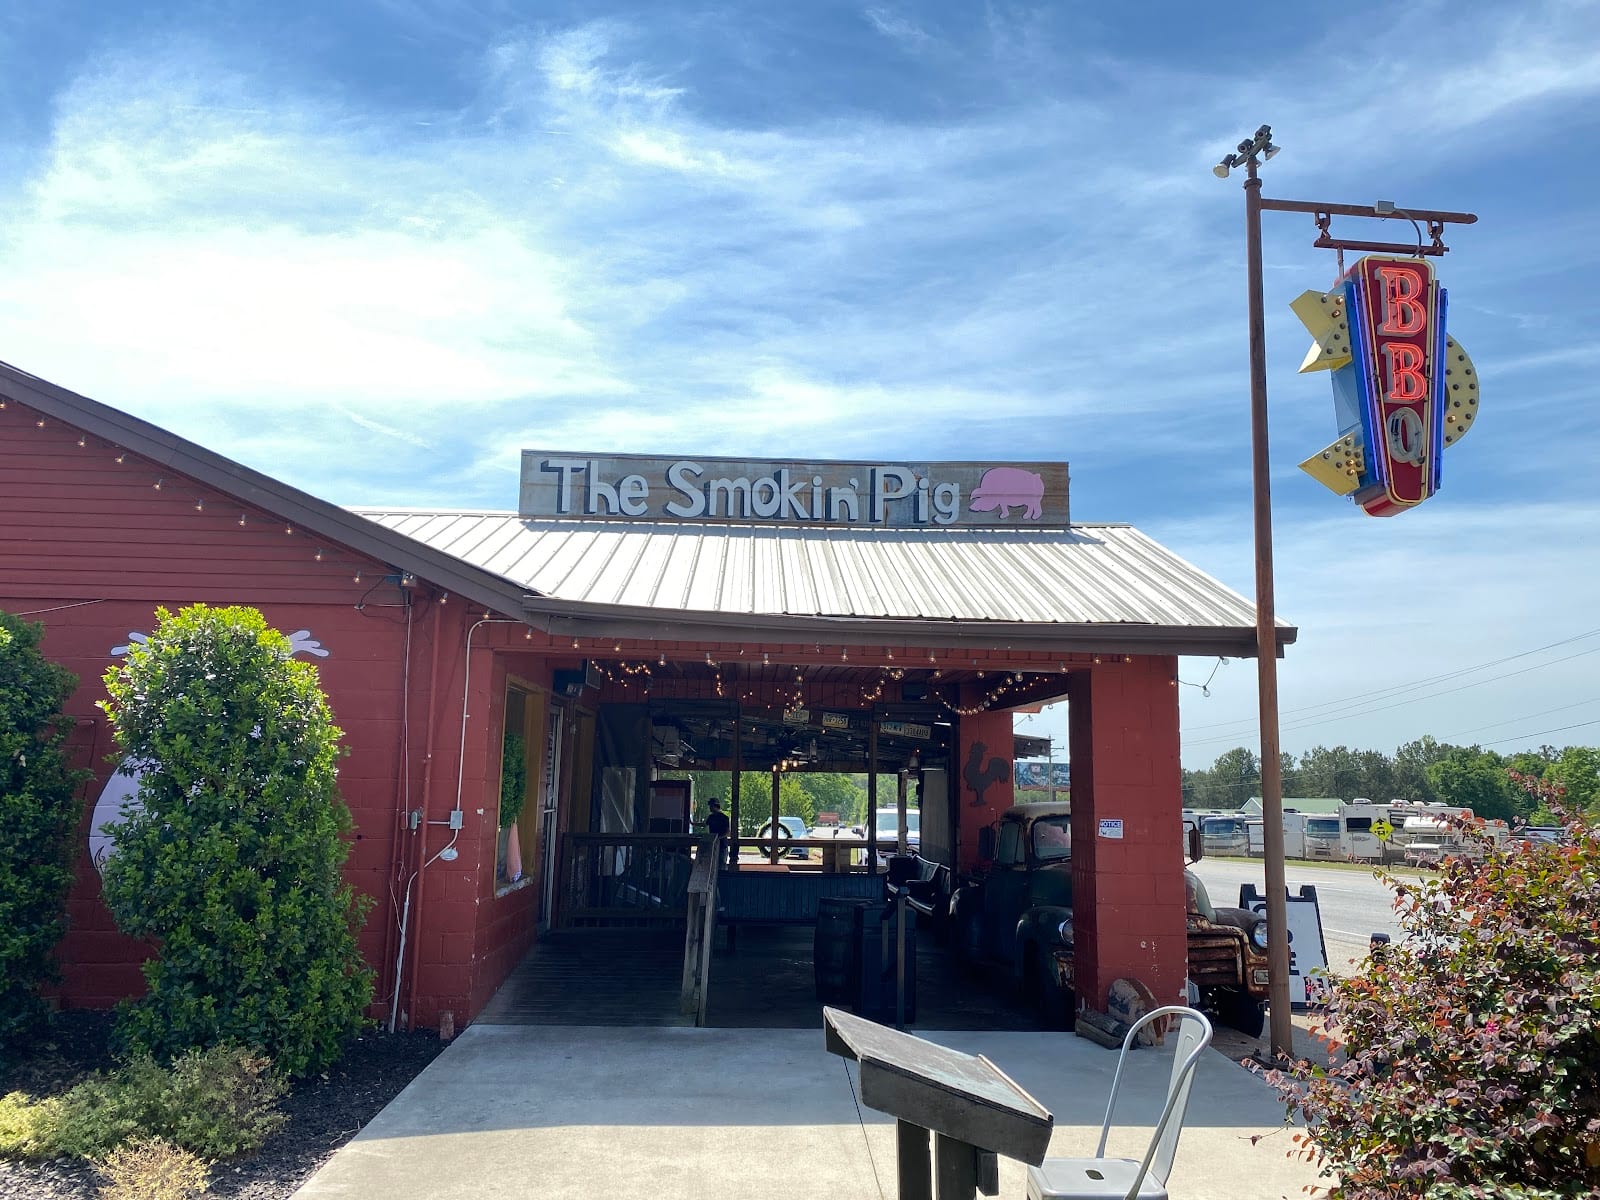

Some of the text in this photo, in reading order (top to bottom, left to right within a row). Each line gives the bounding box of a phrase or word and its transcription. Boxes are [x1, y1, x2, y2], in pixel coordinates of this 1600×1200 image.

[1375, 266, 1427, 467] BBQ
[541, 460, 960, 525] The Smokin' Pig
[1100, 820, 1122, 828] NOTICE
